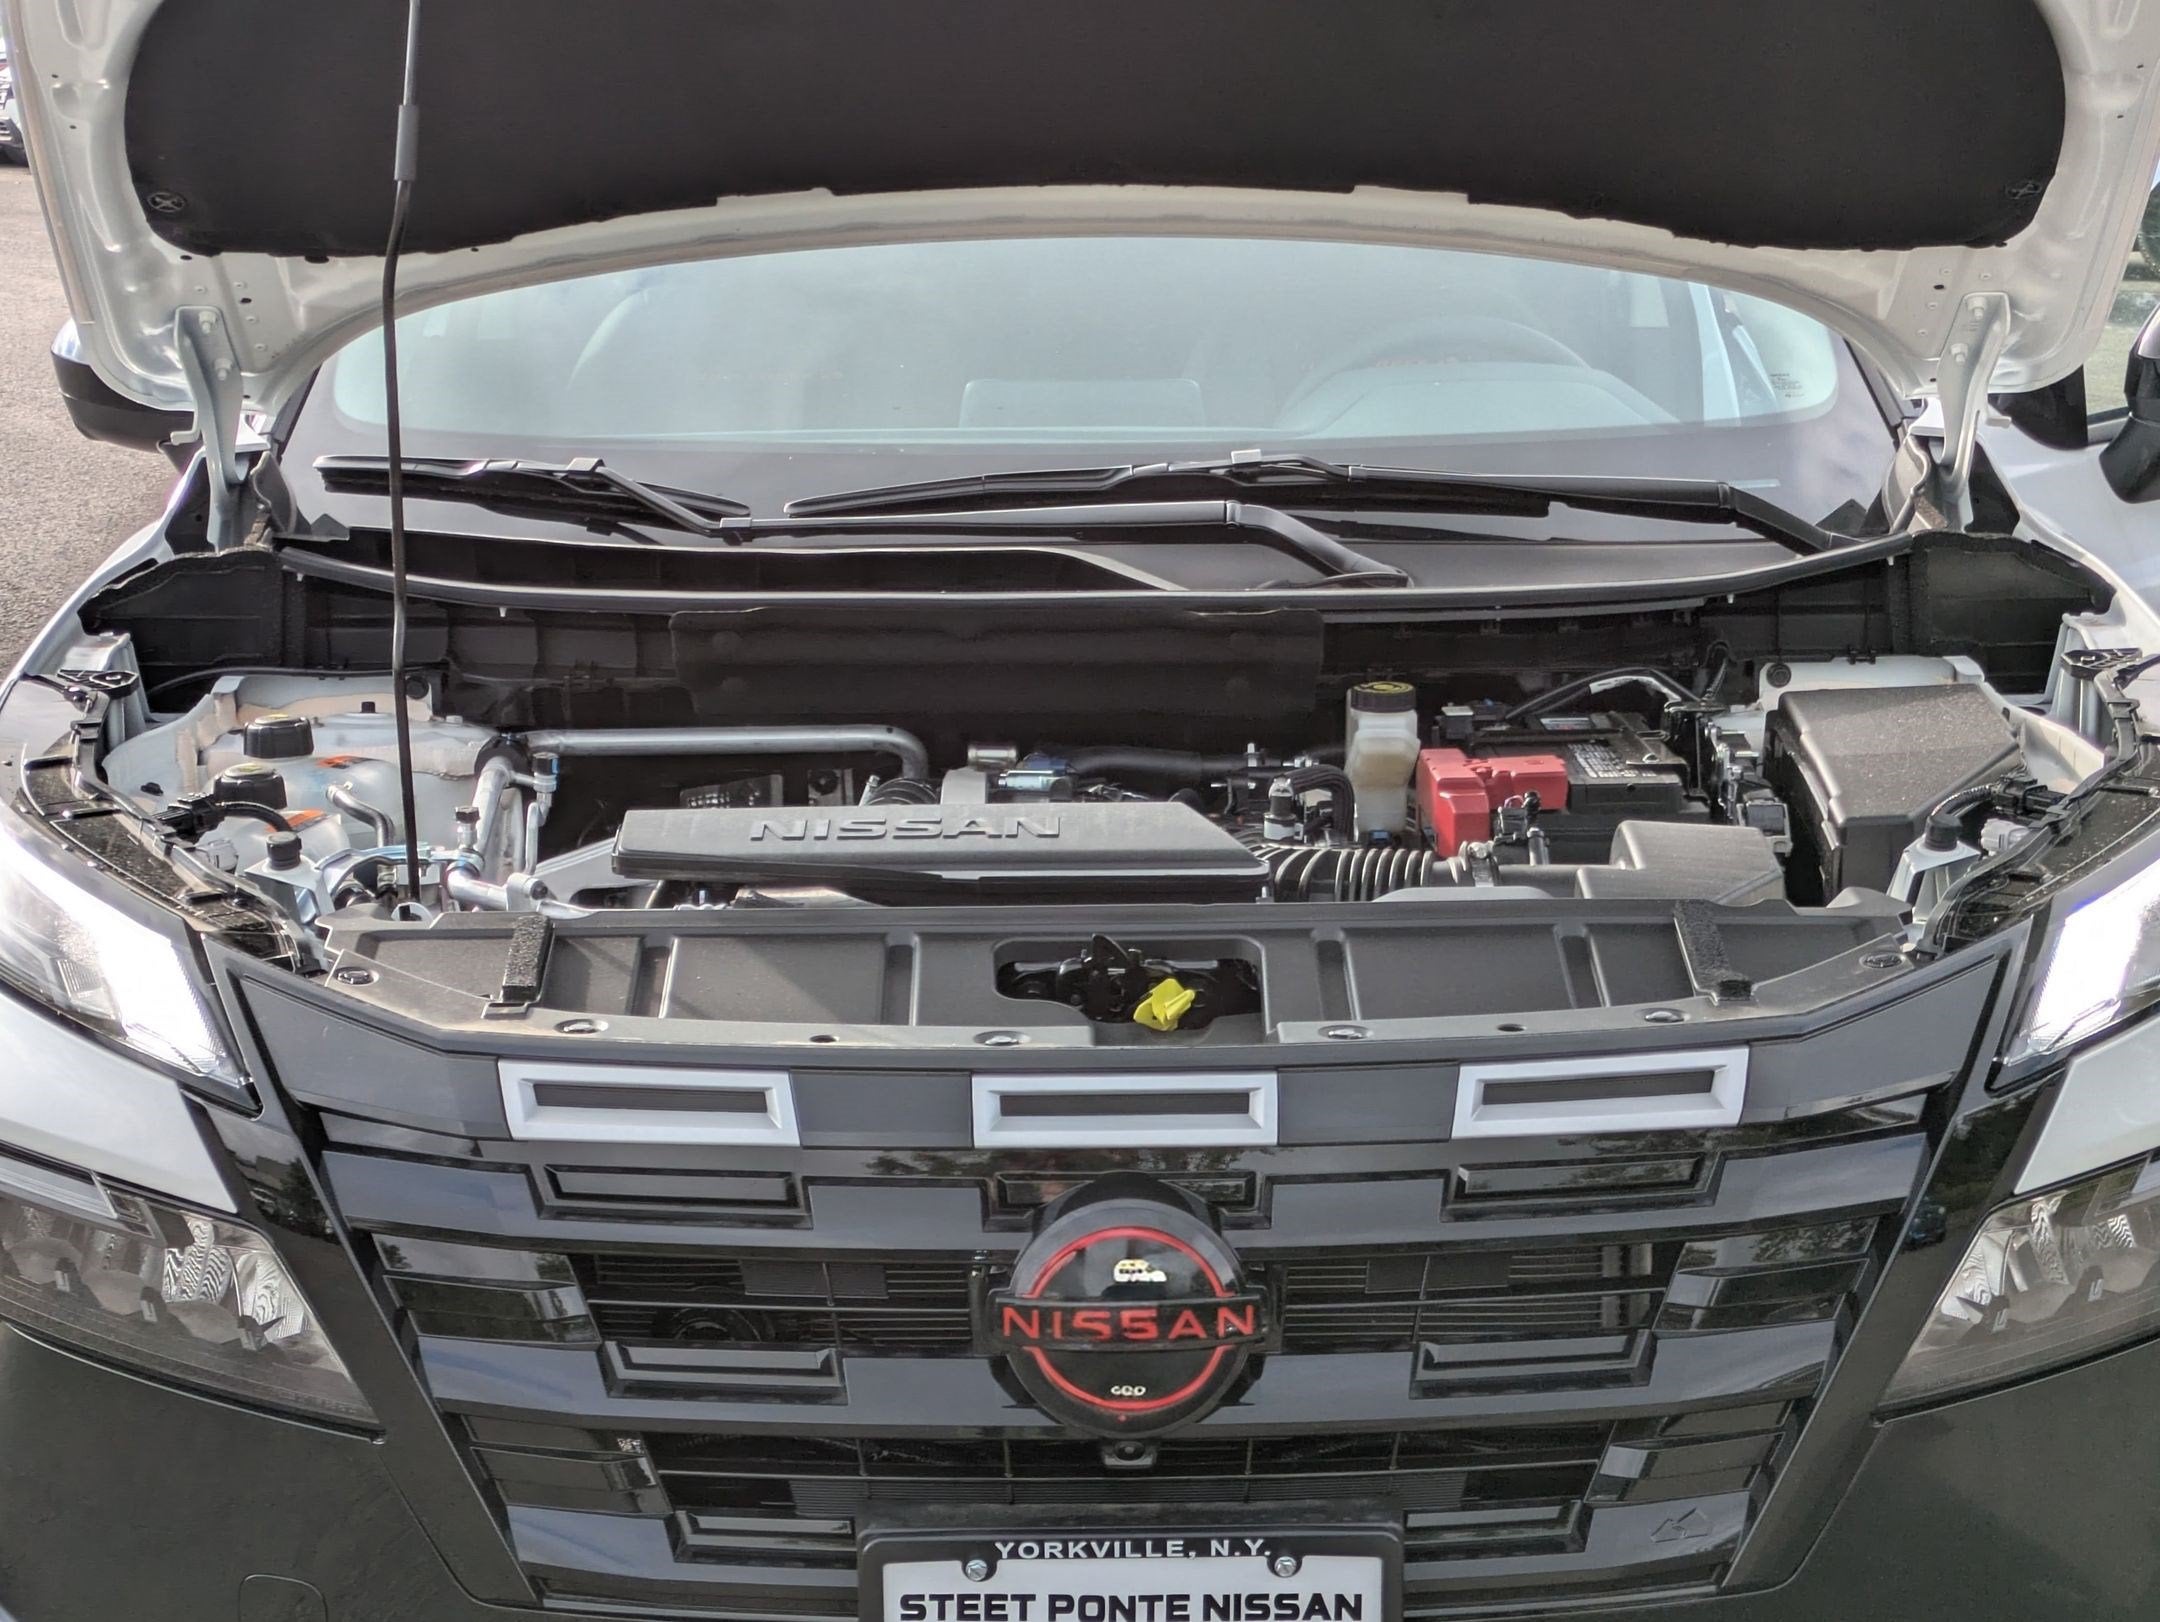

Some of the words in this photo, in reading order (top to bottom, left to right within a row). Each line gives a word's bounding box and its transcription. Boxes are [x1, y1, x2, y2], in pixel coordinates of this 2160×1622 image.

[750, 817, 1061, 841] NISSAN
[1001, 1305, 1256, 1341] NISSAN
[995, 1540, 1197, 1560] YORKVILLE,
[1210, 1539, 1271, 1557] N.Y.
[899, 1593, 1037, 1622] STEET
[1048, 1593, 1191, 1622] PONTE
[1203, 1592, 1363, 1622] NISSAN
